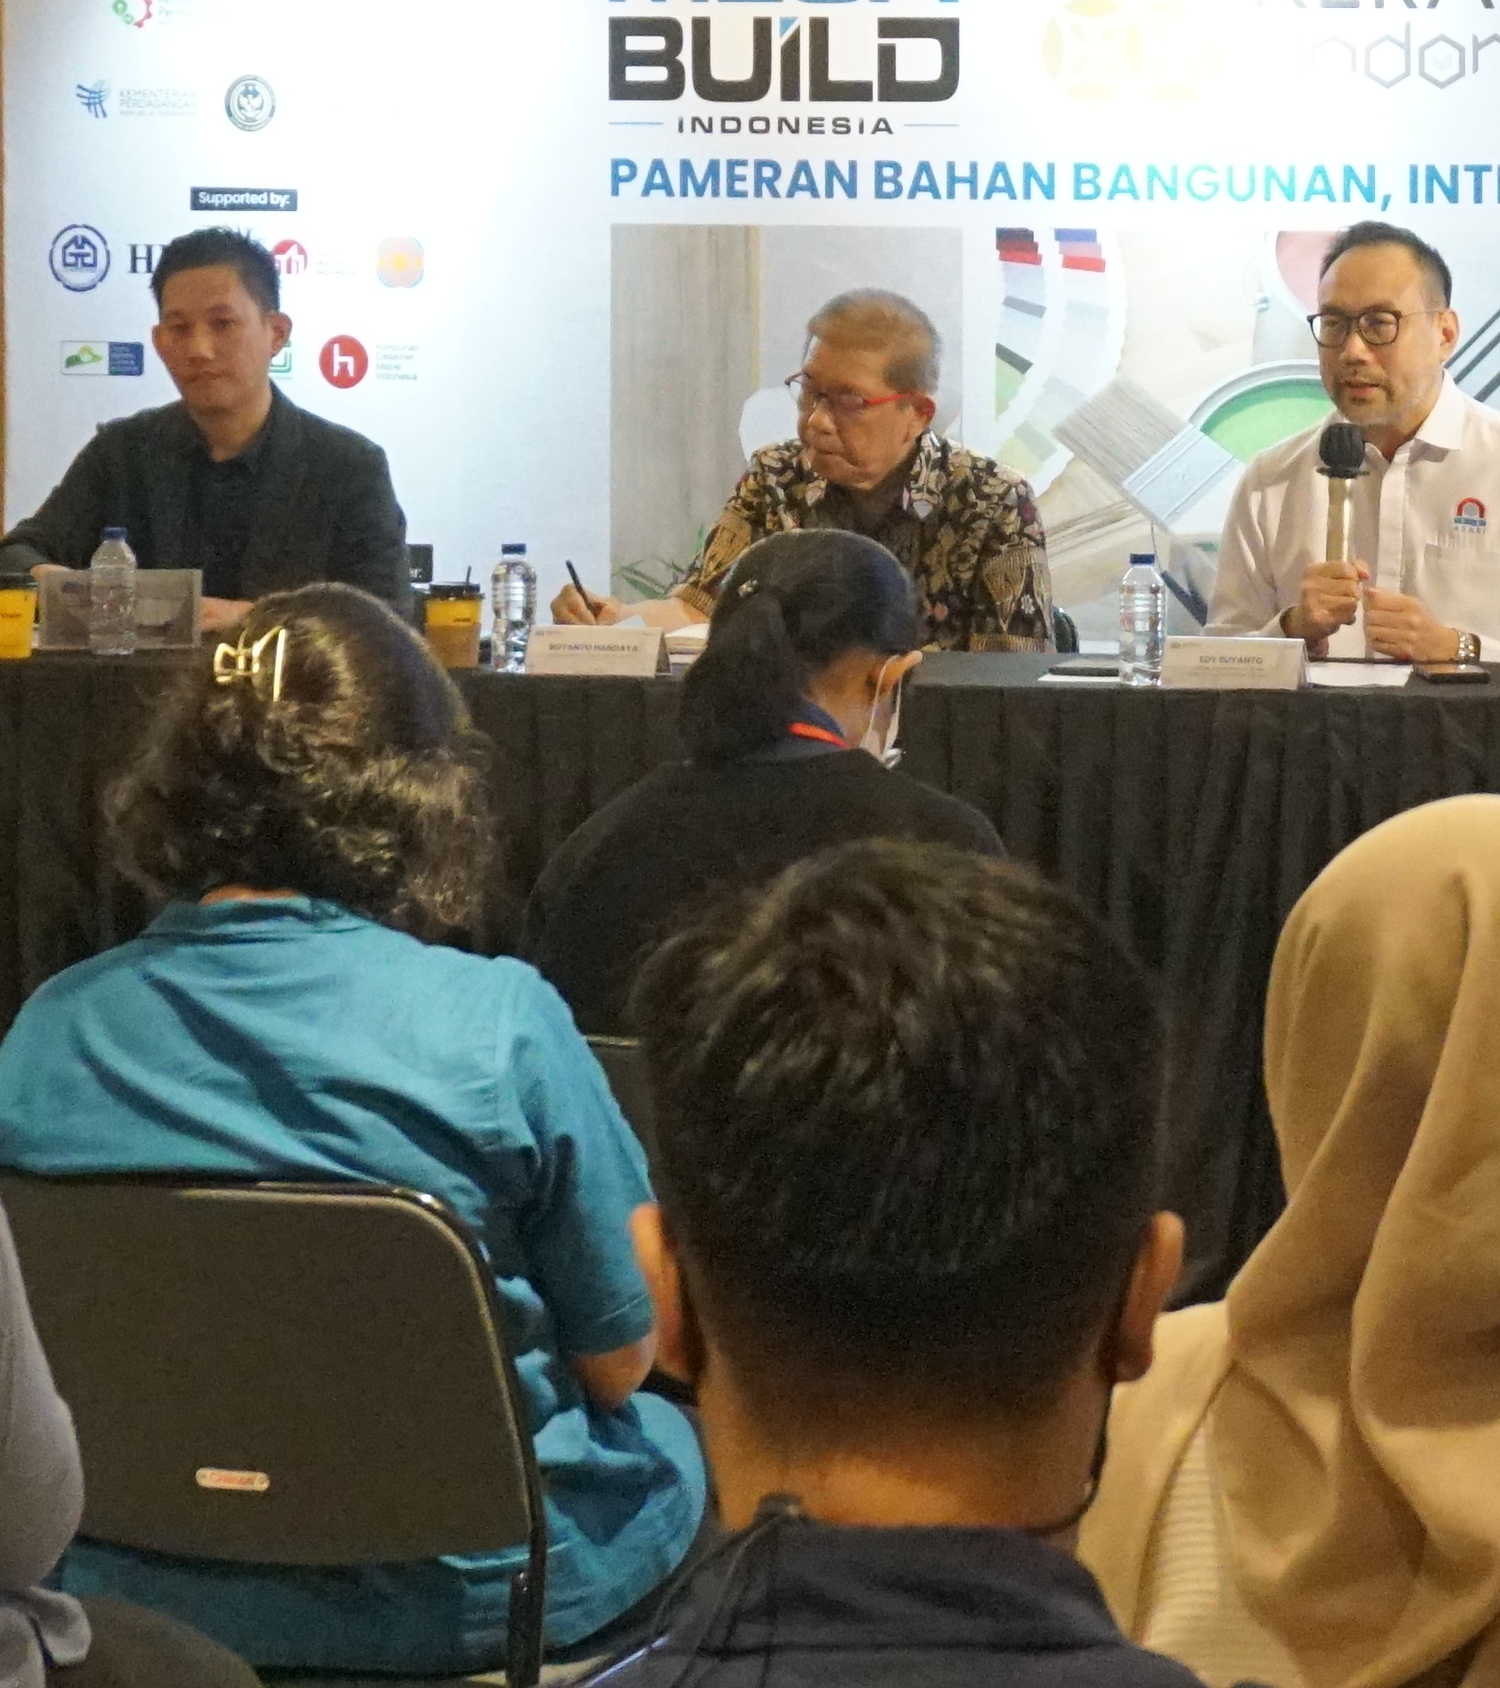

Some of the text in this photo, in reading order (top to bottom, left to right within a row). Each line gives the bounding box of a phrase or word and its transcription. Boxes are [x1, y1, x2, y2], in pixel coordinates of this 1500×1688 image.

[607, 15, 961, 103] BUILD
[677, 115, 895, 136] INDONESIA
[198, 190, 268, 207] Supported
[609, 157, 860, 202] PAMERAN
[873, 159, 1057, 203] BAHAN
[1071, 162, 1395, 213] BANGUNAN,
